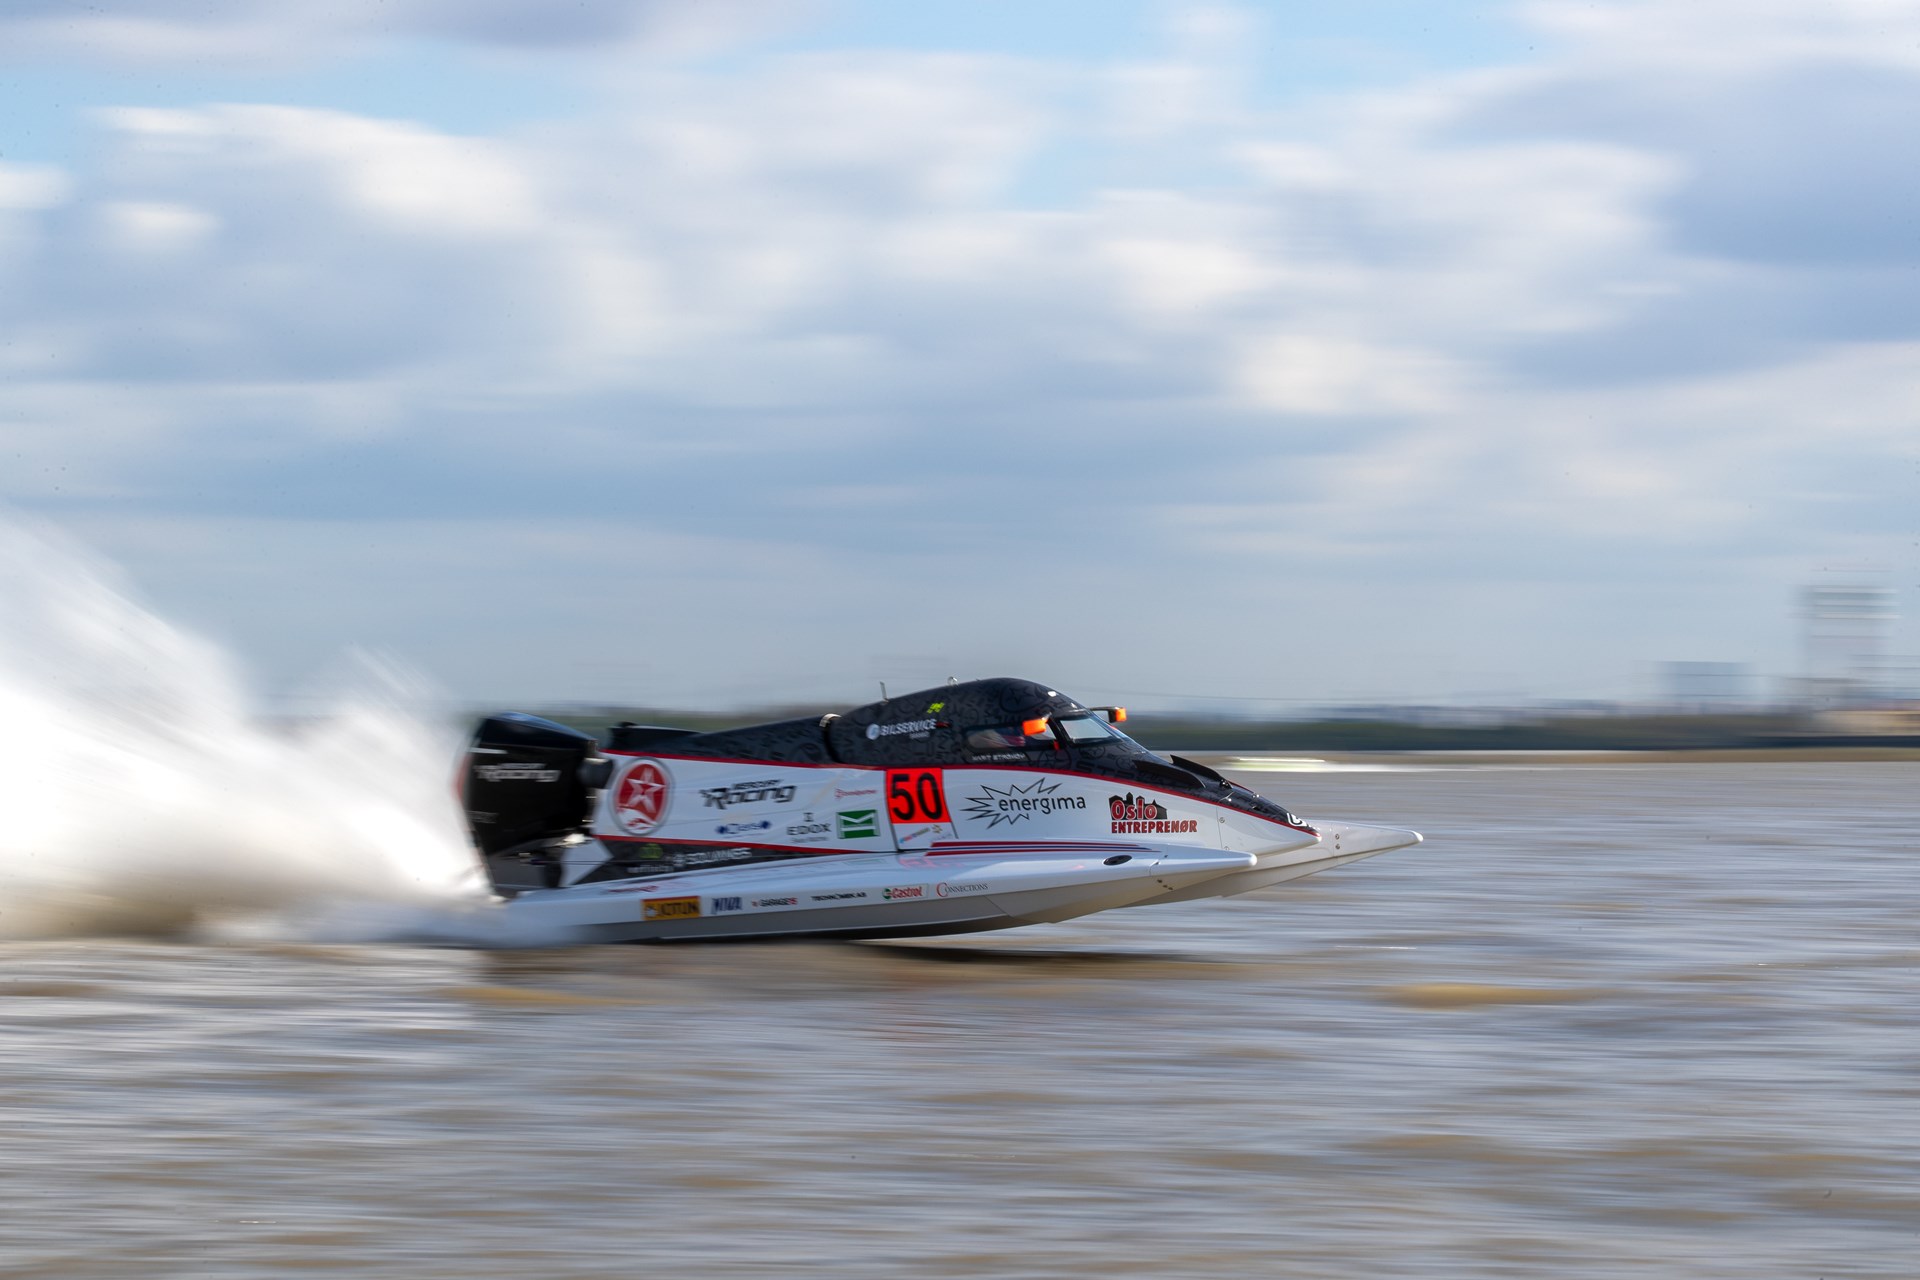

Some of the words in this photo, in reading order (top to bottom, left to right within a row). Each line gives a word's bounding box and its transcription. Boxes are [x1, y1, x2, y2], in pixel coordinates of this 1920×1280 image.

[880, 719, 937, 736] BILSERVICE
[699, 785, 797, 810] Racing
[891, 773, 943, 820] 50
[999, 796, 1087, 815] energima
[1111, 799, 1158, 820] Oslo
[787, 823, 832, 835] EDOX
[1111, 820, 1198, 834] ENTREPRENØR
[890, 886, 923, 899] Castrol
[937, 882, 989, 897] CONNECTIONS
